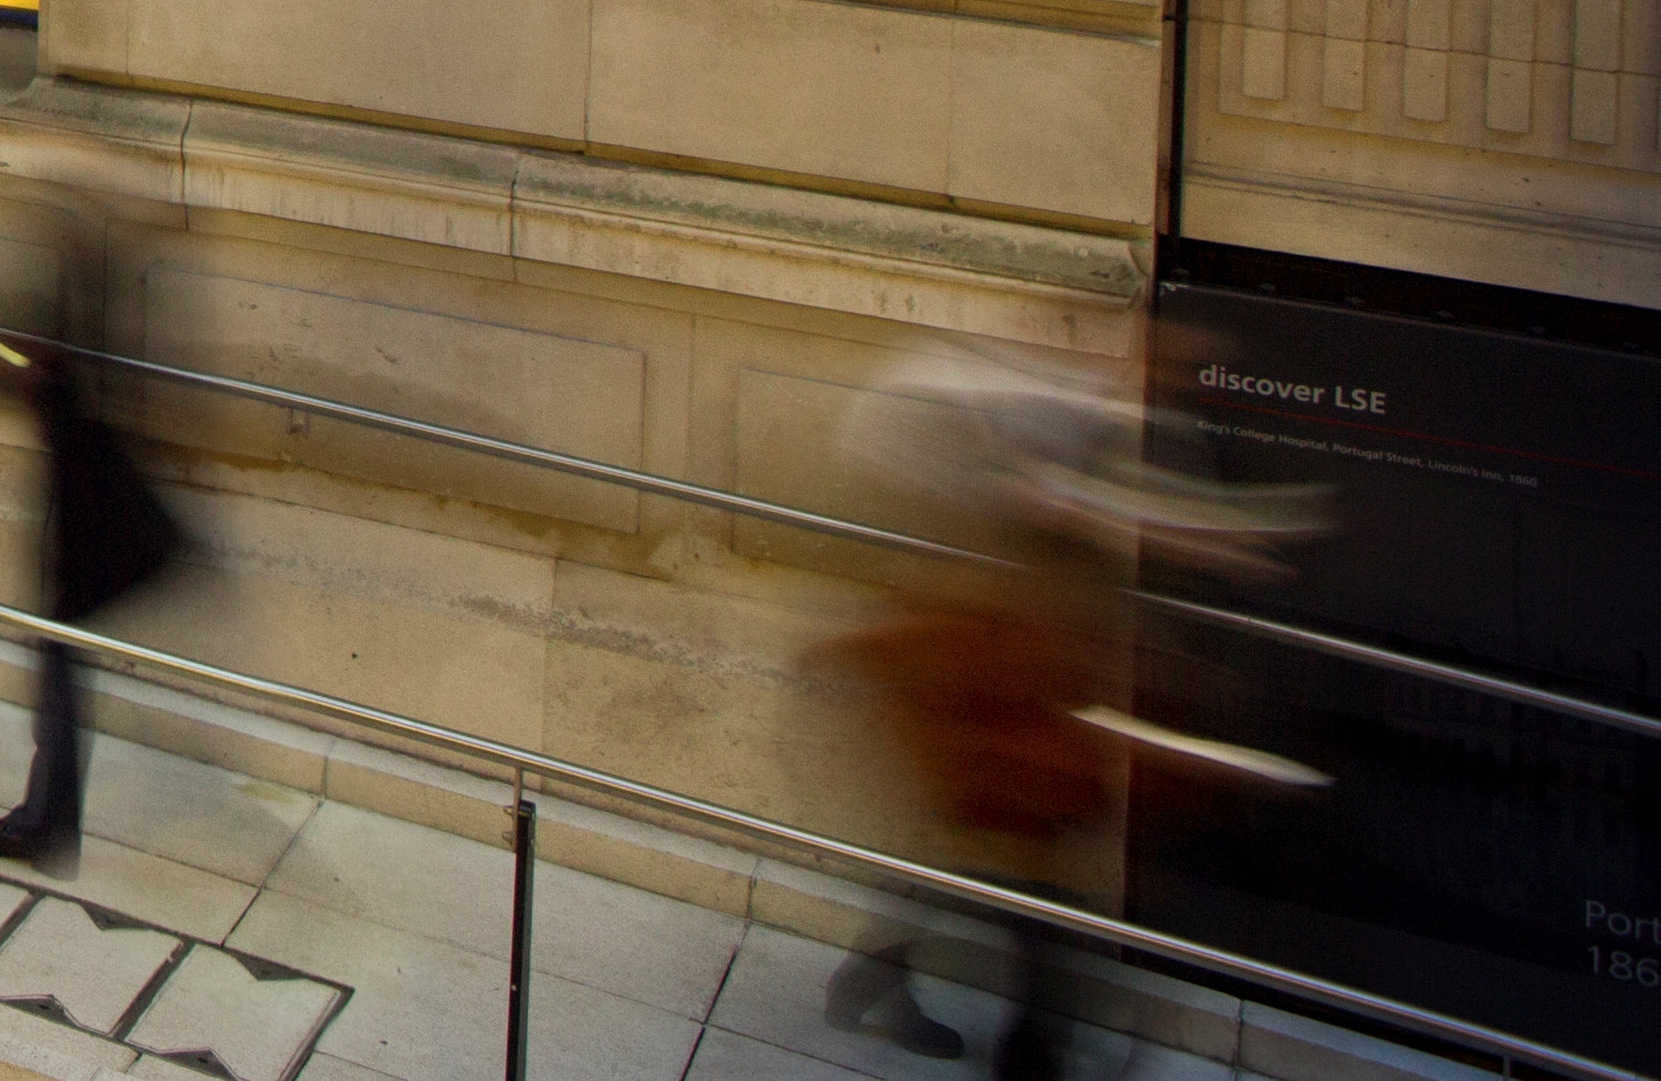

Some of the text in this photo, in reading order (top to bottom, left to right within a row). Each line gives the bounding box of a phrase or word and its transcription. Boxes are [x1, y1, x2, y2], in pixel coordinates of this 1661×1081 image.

[1199, 365, 1387, 414] discover LSE
[1197, 420, 1231, 435] King's
[1233, 426, 1275, 443] College
[1279, 434, 1329, 452] Hospital,
[1333, 443, 1382, 461] Portugal
[1386, 452, 1425, 469] Street,
[1428, 459, 1478, 477] Lincoln's
